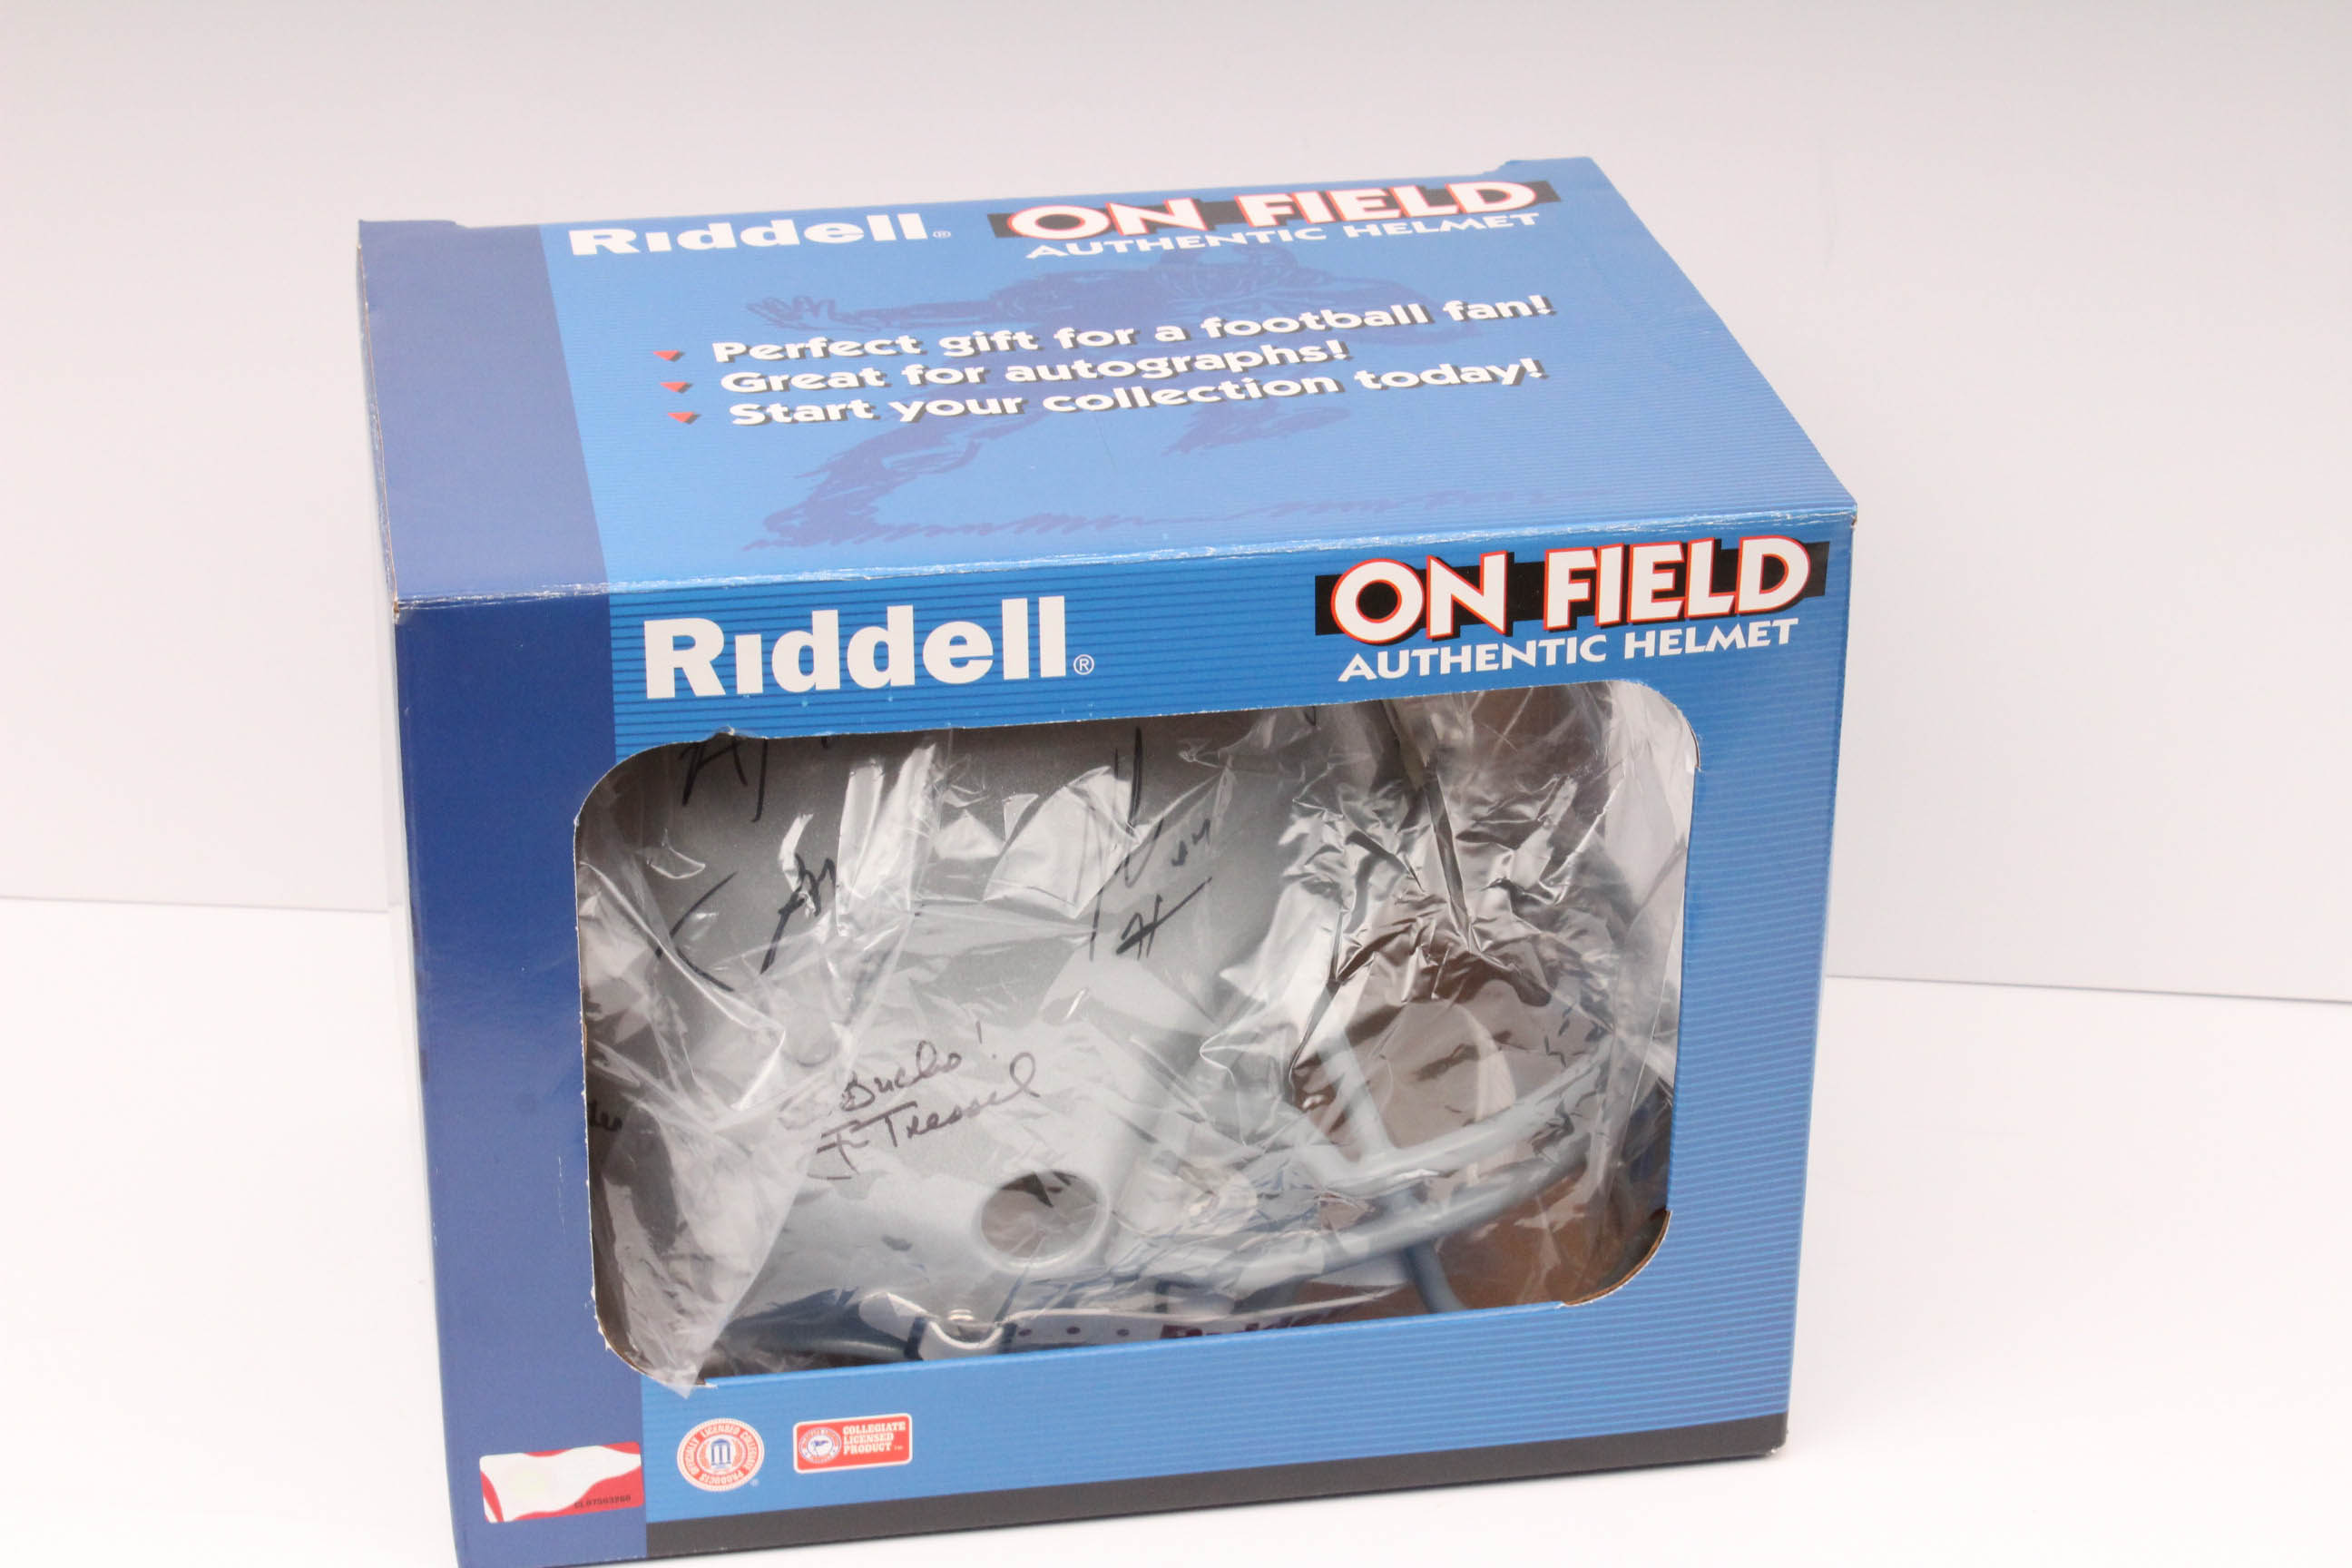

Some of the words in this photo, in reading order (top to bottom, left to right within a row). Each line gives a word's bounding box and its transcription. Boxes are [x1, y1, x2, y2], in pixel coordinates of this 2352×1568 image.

[1006, 198, 1210, 240] ON
[1234, 181, 1539, 228] FIELD
[1025, 228, 1326, 259] AUTHENTIC
[1343, 212, 1540, 238] HELMET
[712, 335, 924, 363] Perfect
[938, 328, 1040, 358] gift
[1054, 325, 1137, 349] for
[1154, 323, 1189, 343] a
[1200, 303, 1431, 338] football
[1443, 295, 1556, 322] fan!
[720, 367, 887, 394] Great
[902, 362, 985, 386] for
[1004, 339, 1350, 379] autographs!
[730, 397, 879, 426] Start
[889, 394, 1027, 424] your
[1042, 374, 1342, 414] collection
[1354, 358, 1550, 387] today!
[1330, 550, 1510, 645] ON
[1544, 534, 1811, 631] FIELD
[1338, 633, 1606, 682] AUTHENTIC
[1623, 617, 1799, 660] HELMET
[700, 1422, 741, 1438] LICENSED
[842, 1421, 906, 1436] COLLEGIATE
[843, 1442, 892, 1455] PRODUCT
[844, 1433, 894, 1446] LICENSED
[698, 1468, 745, 1486] PRODUCTS
